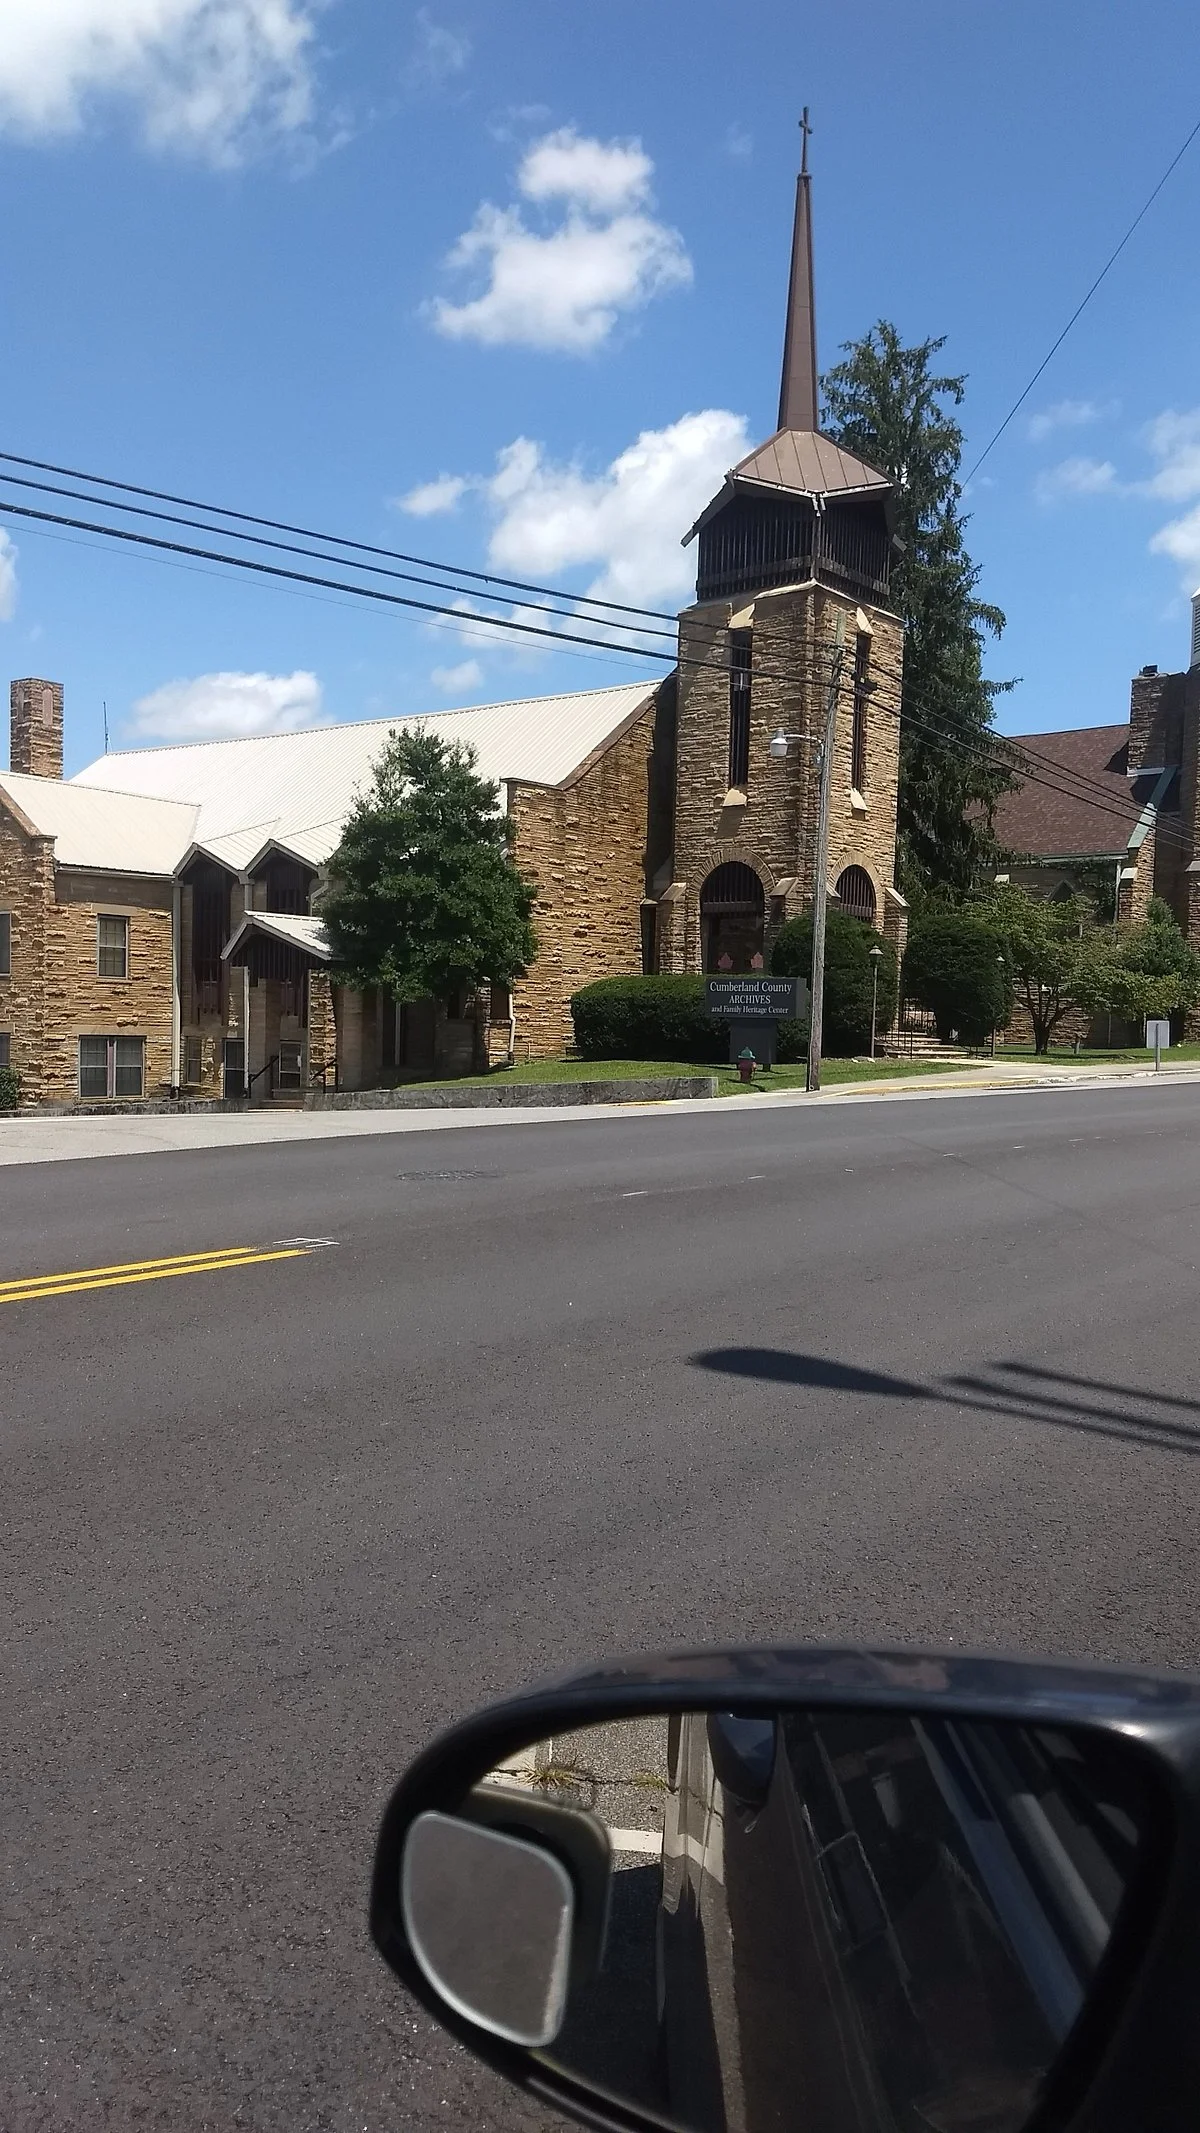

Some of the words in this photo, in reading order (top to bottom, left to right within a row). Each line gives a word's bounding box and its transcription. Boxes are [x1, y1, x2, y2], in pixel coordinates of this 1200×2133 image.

[709, 981, 760, 992] Cumberland
[761, 981, 792, 994] County
[729, 995, 771, 1004] ARCHIVES
[711, 1005, 722, 1013] and
[723, 1005, 742, 1014] Family
[743, 1005, 767, 1015] Heritage
[768, 1006, 789, 1014] Center
